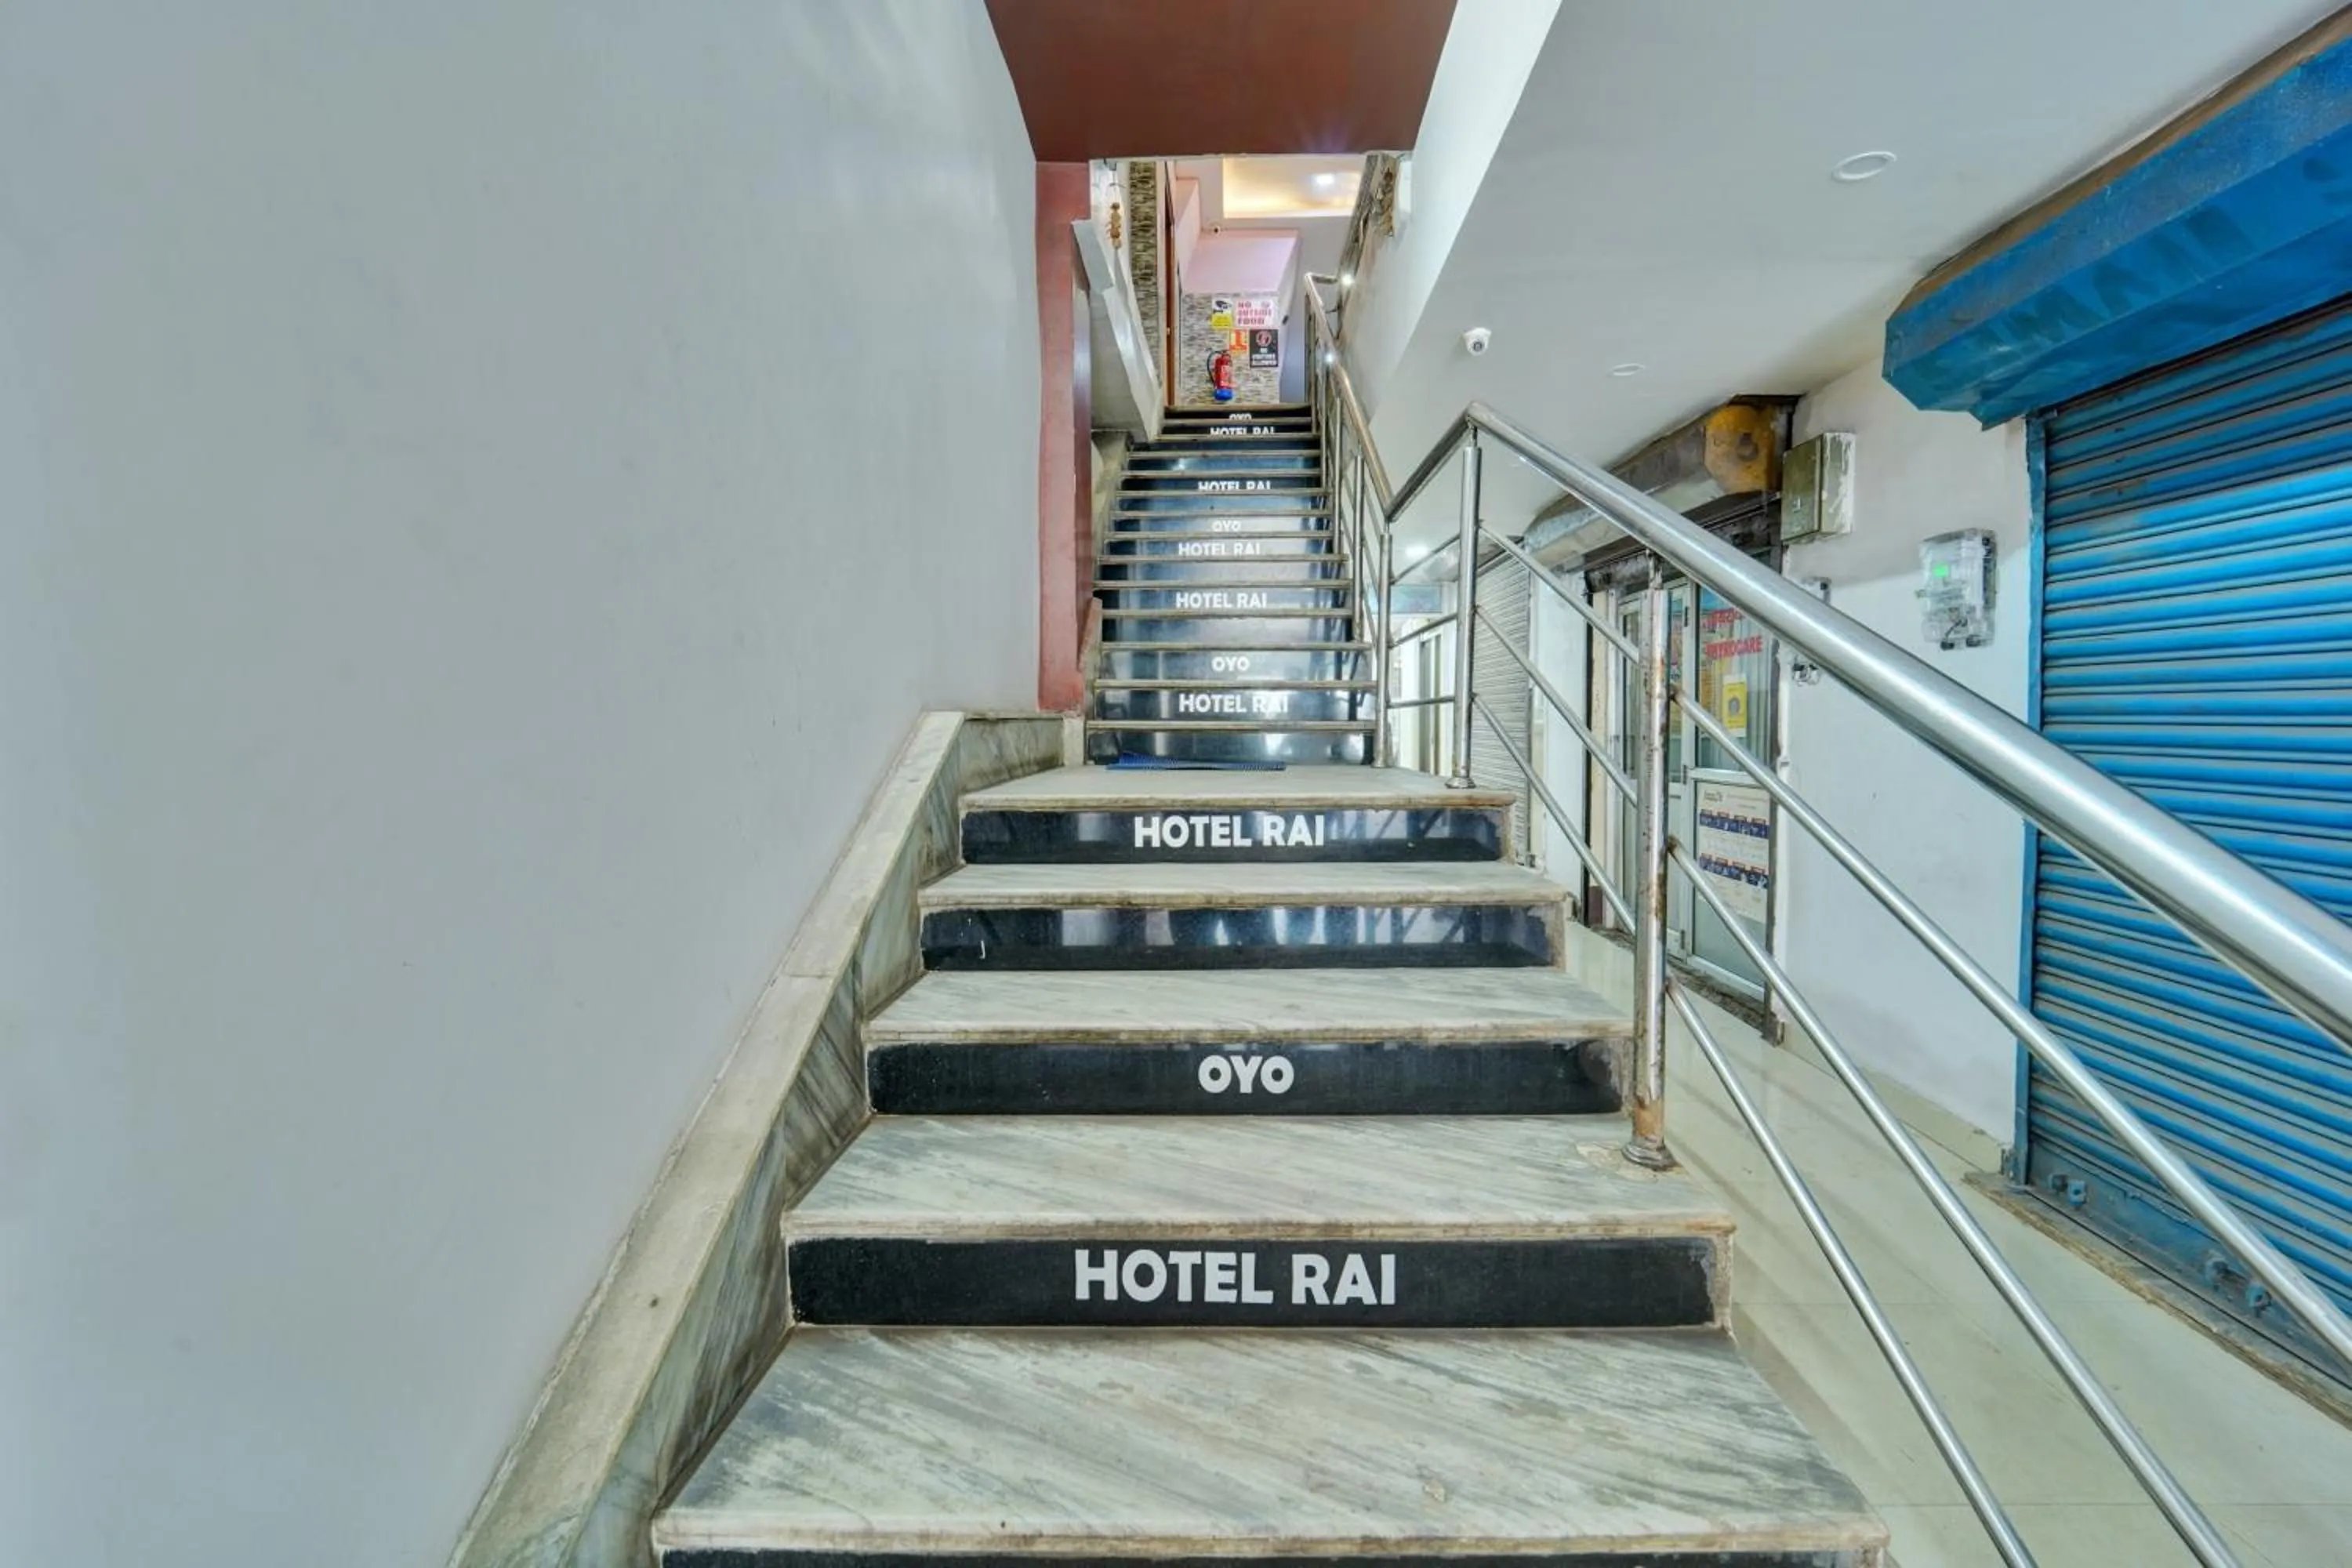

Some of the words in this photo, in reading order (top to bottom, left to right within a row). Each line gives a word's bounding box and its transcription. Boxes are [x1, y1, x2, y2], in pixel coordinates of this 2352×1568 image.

[1211, 520, 1242, 532] OYO
[1178, 543, 1228, 556] HOTEL
[1233, 543, 1260, 555] RAI
[1176, 592, 1232, 608] HOTEL
[1237, 592, 1268, 608] RAI
[1211, 656, 1250, 673] OYO
[1178, 694, 1247, 713] HOTEL
[1252, 694, 1289, 713] RAI
[1134, 815, 1251, 848] HOTEL
[1261, 815, 1325, 847] RAI
[1198, 1055, 1294, 1094] OYO
[1074, 1249, 1273, 1305] HOTEL
[1291, 1252, 1397, 1305] RAI
